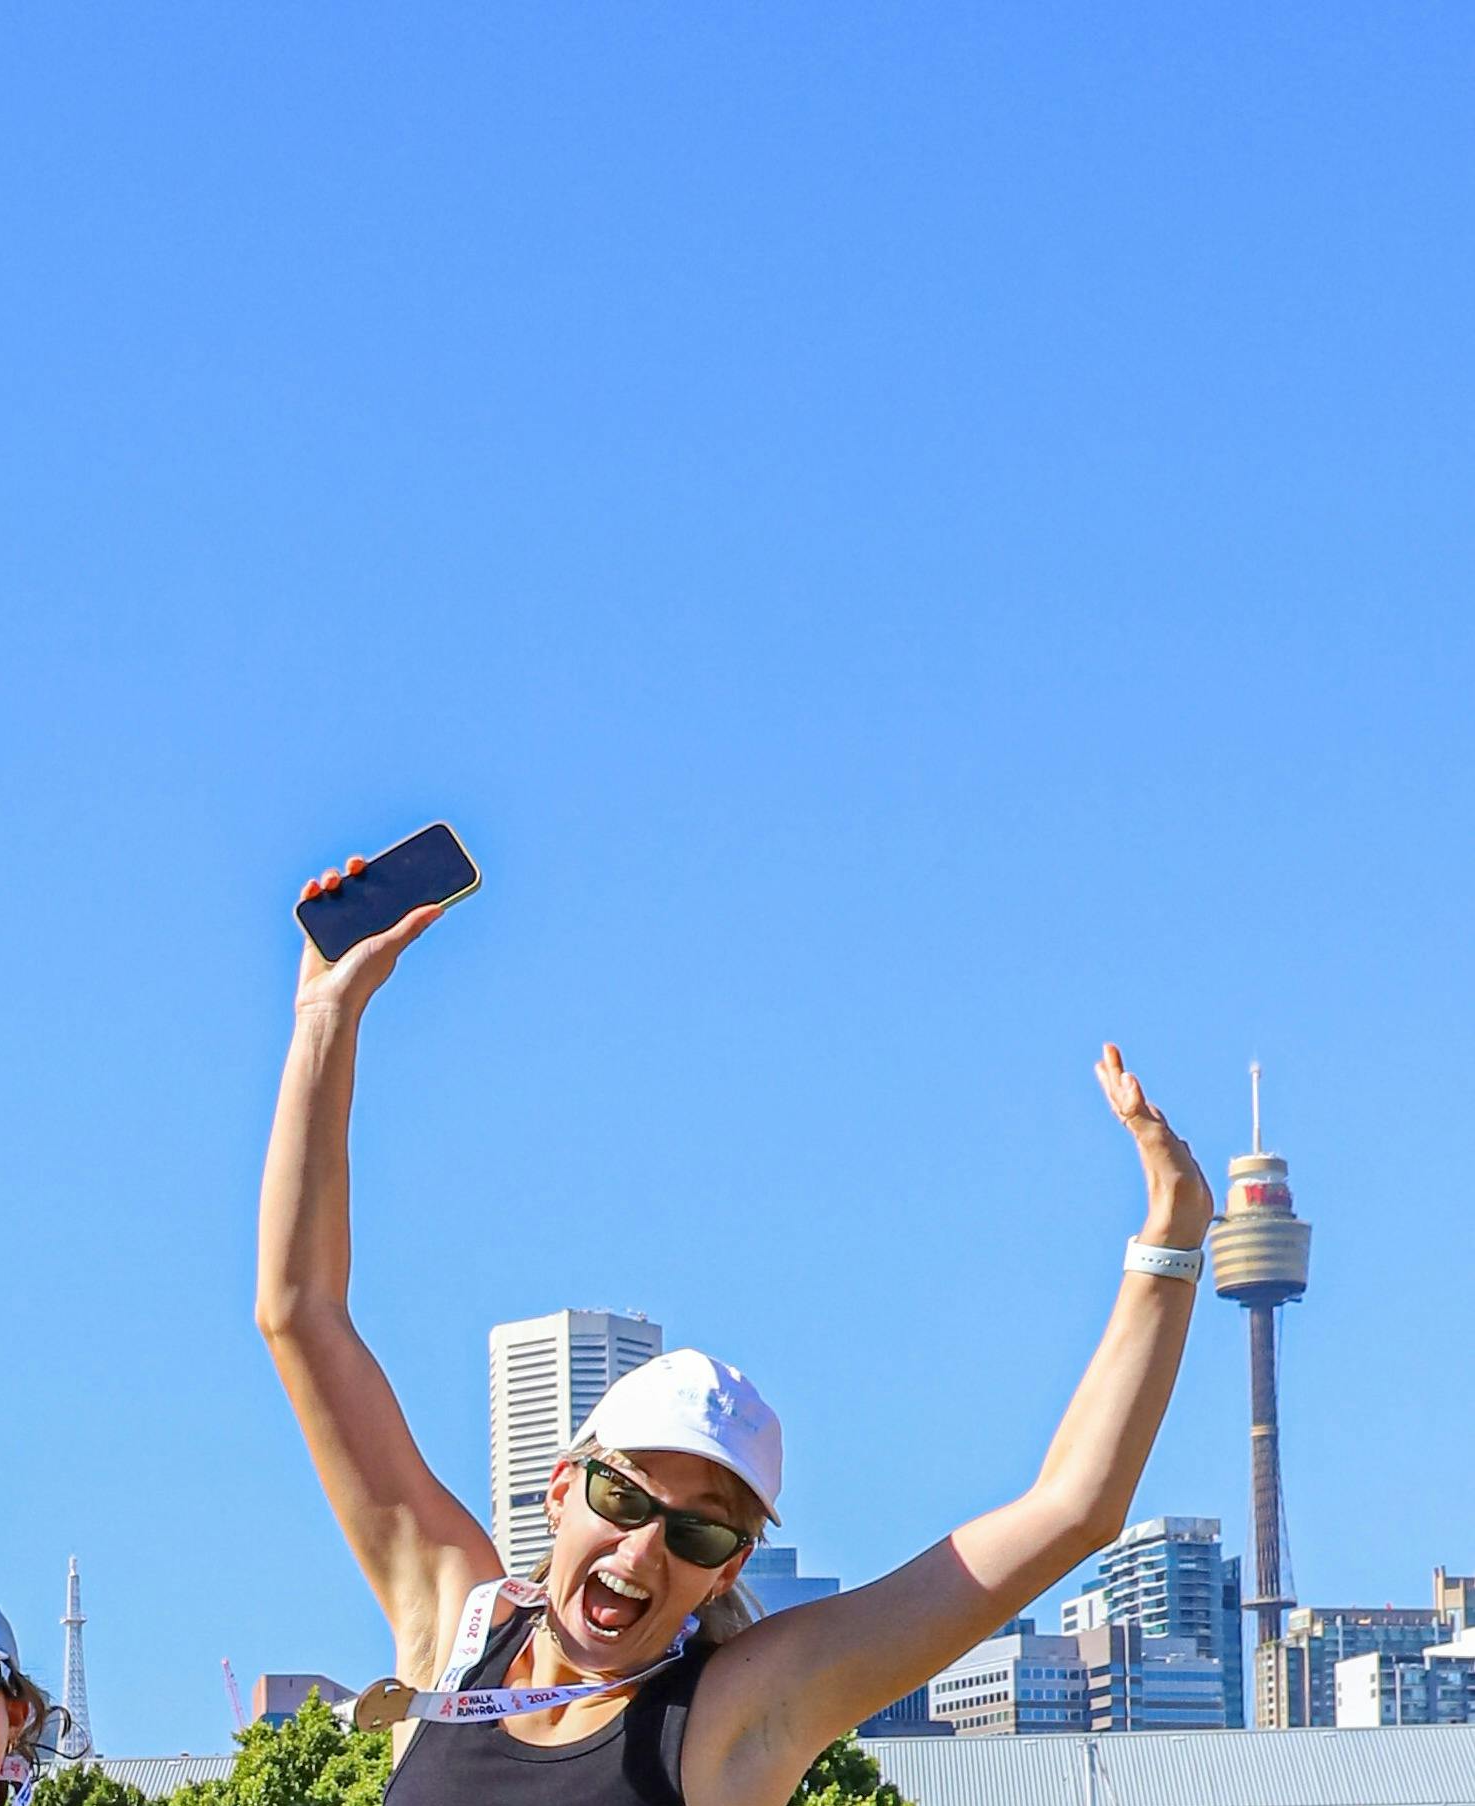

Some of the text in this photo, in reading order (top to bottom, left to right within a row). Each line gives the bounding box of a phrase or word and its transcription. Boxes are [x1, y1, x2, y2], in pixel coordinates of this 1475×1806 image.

[467, 1608, 483, 1638] 2024
[469, 1694, 494, 1705] WALK
[526, 1692, 560, 1704] 2024
